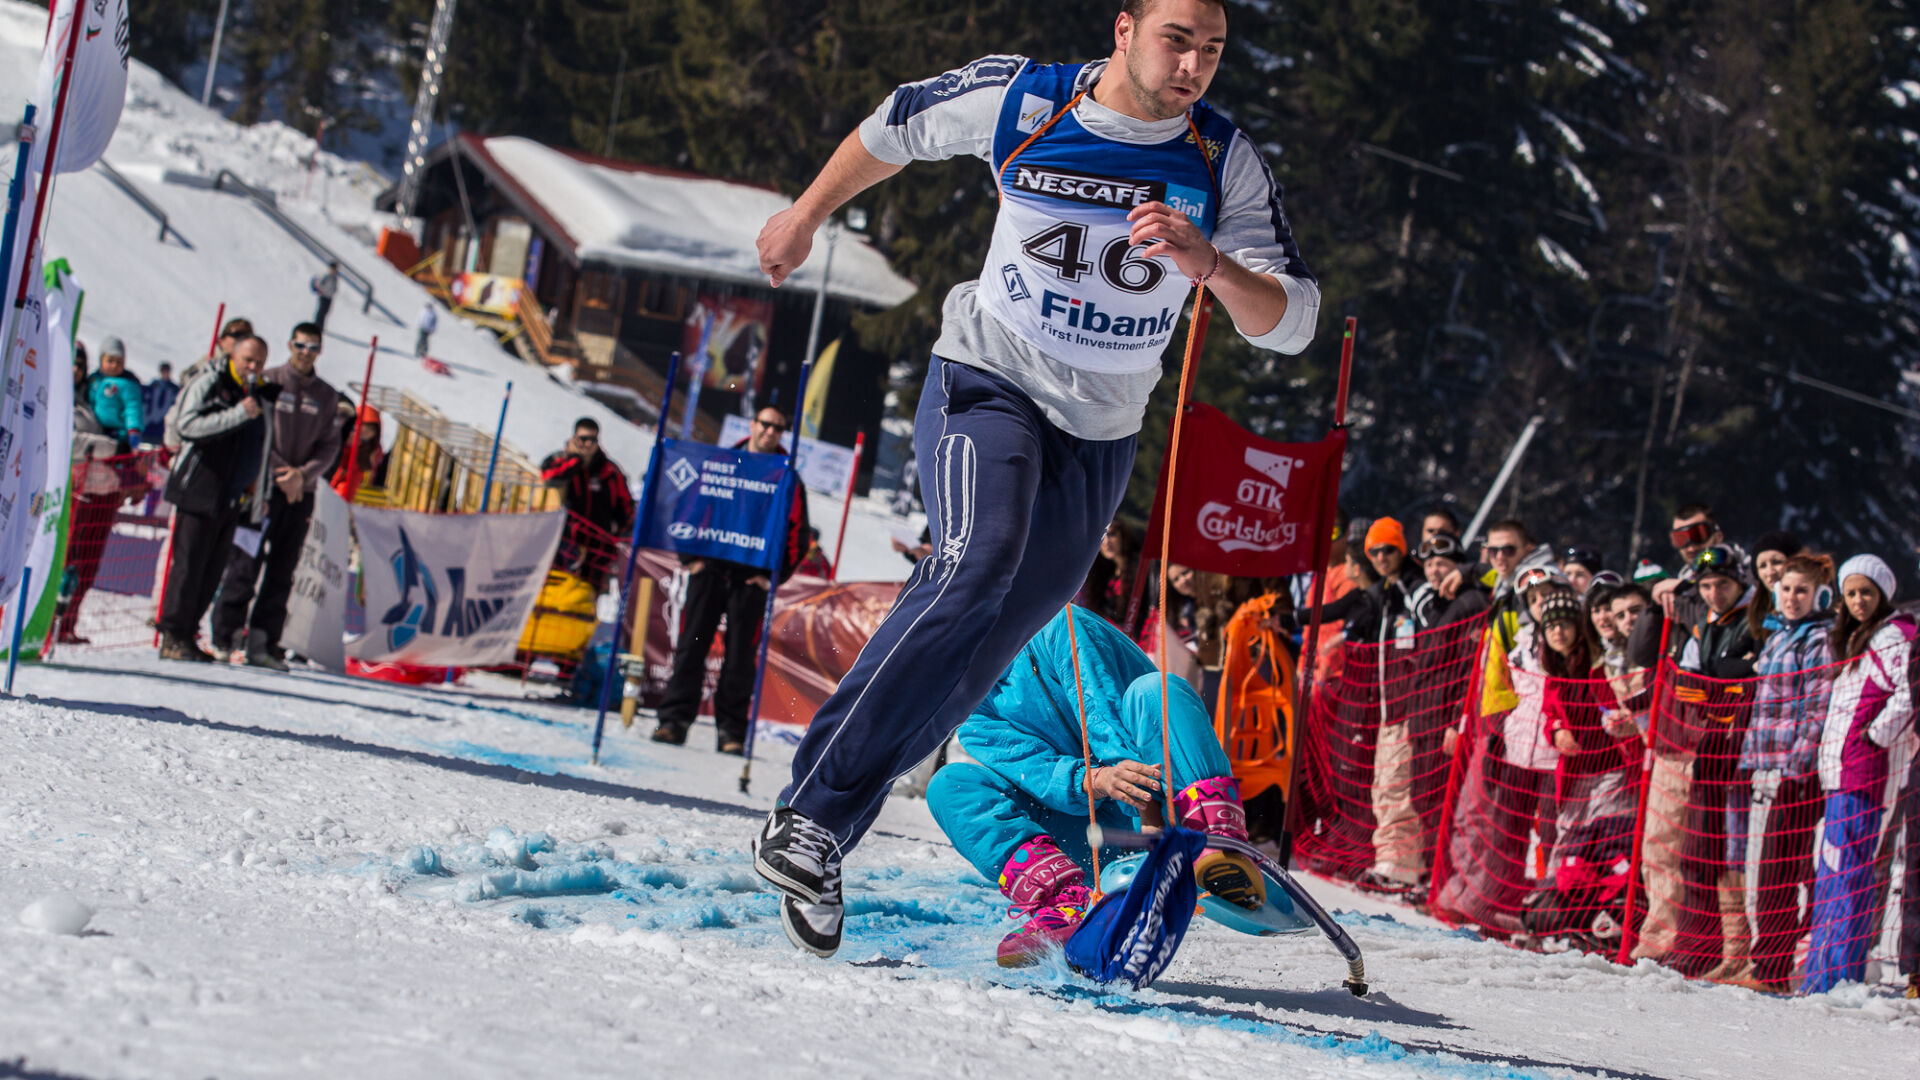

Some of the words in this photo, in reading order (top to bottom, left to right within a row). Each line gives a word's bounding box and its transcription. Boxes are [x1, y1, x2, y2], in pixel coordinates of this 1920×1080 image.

[1017, 166, 1151, 207] NESCAFÉ
[1166, 195, 1205, 219] 3in1
[1021, 221, 1167, 294] 46
[1041, 289, 1176, 337] Fibank
[1041, 321, 1072, 342] First
[1076, 333, 1146, 351] Investment
[702, 460, 737, 475] FIRST
[699, 485, 735, 500] BANK
[701, 473, 779, 495] INVESTMENT
[1196, 501, 1299, 546] Carlsberg
[697, 527, 766, 551] HYUNDAI
